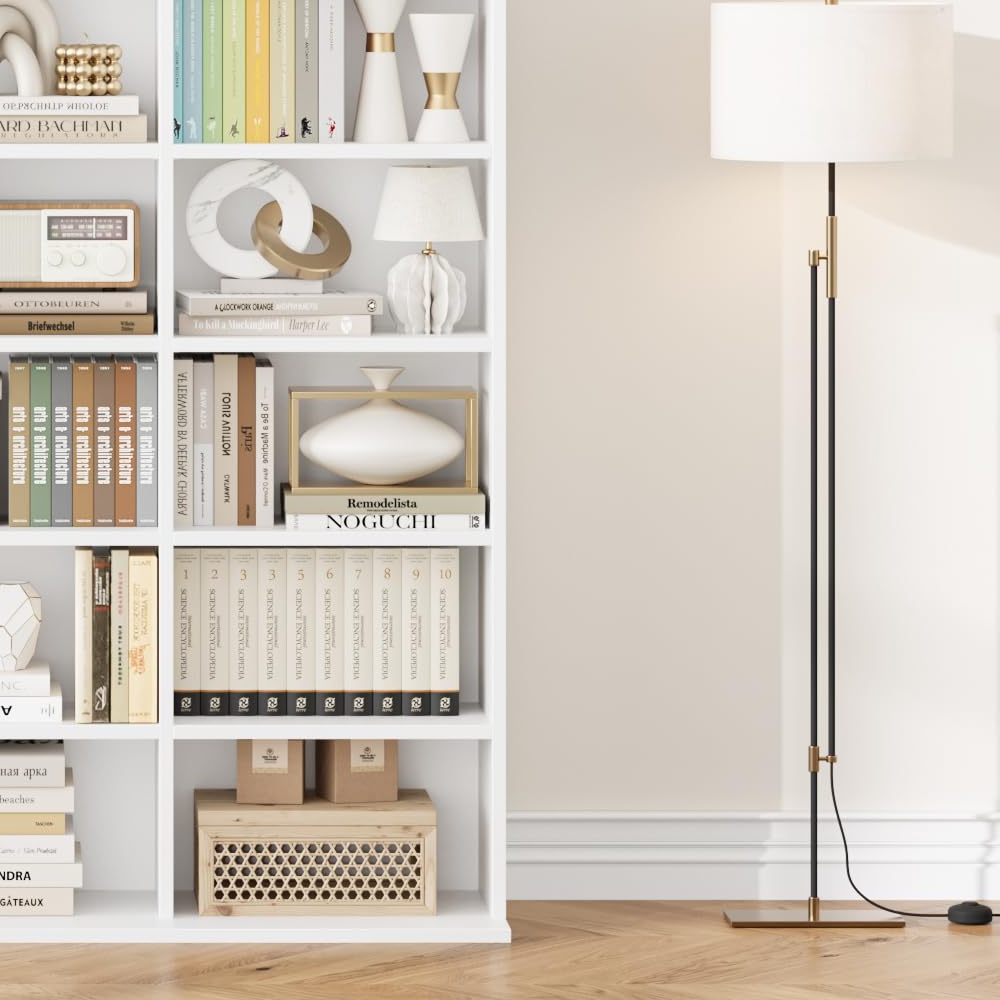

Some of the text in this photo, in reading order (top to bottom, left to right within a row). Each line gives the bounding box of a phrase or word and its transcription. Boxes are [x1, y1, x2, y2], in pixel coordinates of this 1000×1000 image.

[38, 120, 123, 132] BACHMAN
[219, 303, 251, 311] CLOCKWORK
[252, 303, 274, 311] ORANGE
[27, 321, 75, 331] Briefwechsel
[288, 319, 329, 331] Harper Lee
[347, 498, 417, 508] Remodelista
[326, 514, 435, 529] NOGUCHI
[183, 569, 189, 580] 1
[211, 569, 219, 580] 2
[240, 569, 247, 580] 3
[268, 569, 276, 580] 3
[297, 569, 305, 580] 5
[326, 569, 334, 580] 6
[354, 569, 362, 580] 7
[384, 569, 391, 580] 8
[412, 569, 420, 580] 9
[439, 569, 452, 580] 10
[23, 765, 47, 780] арка
[0, 795, 35, 806] beaches
[0, 896, 44, 907] GÂTEAUX
